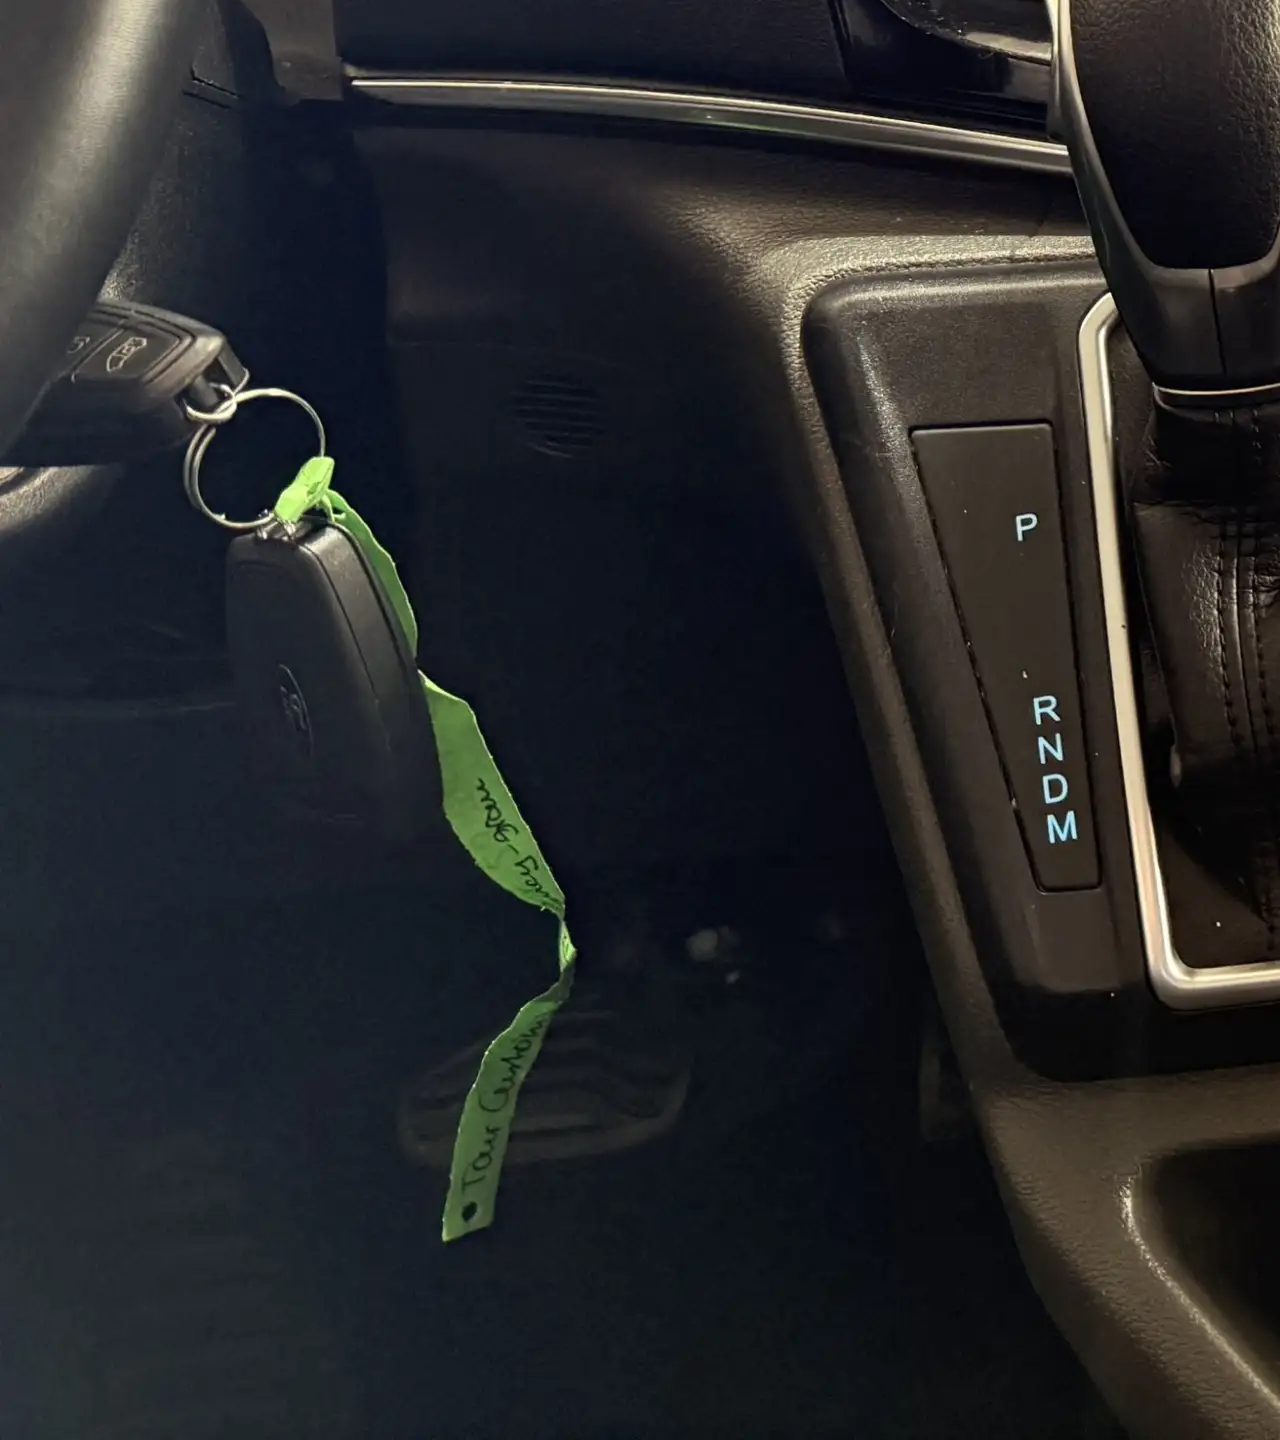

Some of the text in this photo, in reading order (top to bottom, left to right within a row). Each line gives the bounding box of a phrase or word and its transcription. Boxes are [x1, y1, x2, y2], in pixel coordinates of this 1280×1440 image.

[1016, 512, 1039, 542] P
[1033, 694, 1061, 725] R
[1037, 733, 1064, 765] N
[1043, 774, 1068, 804] D
[1046, 810, 1078, 844] M
